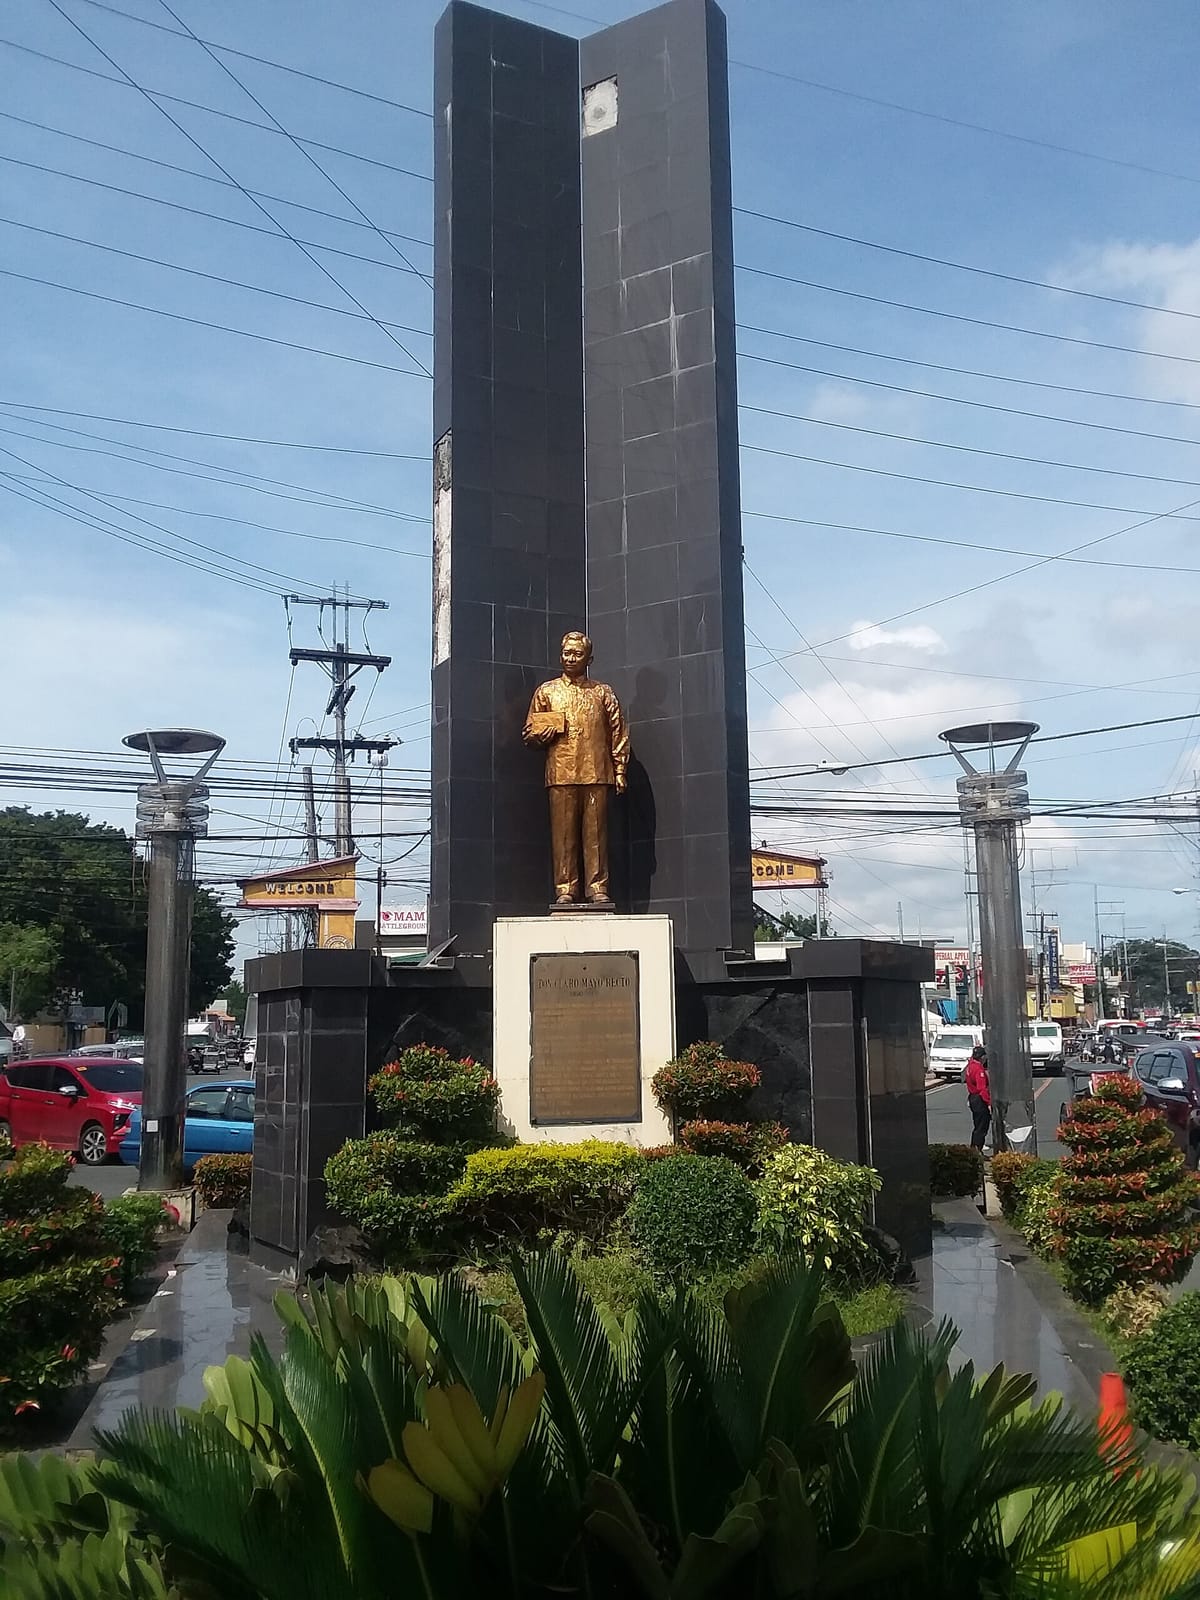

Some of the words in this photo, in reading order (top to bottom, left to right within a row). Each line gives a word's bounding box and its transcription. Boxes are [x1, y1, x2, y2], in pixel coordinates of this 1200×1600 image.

[752, 865, 794, 876] COME
[265, 883, 335, 895] WELCOME
[582, 977, 603, 988] MAYO
[606, 976, 630, 988] RECTO
